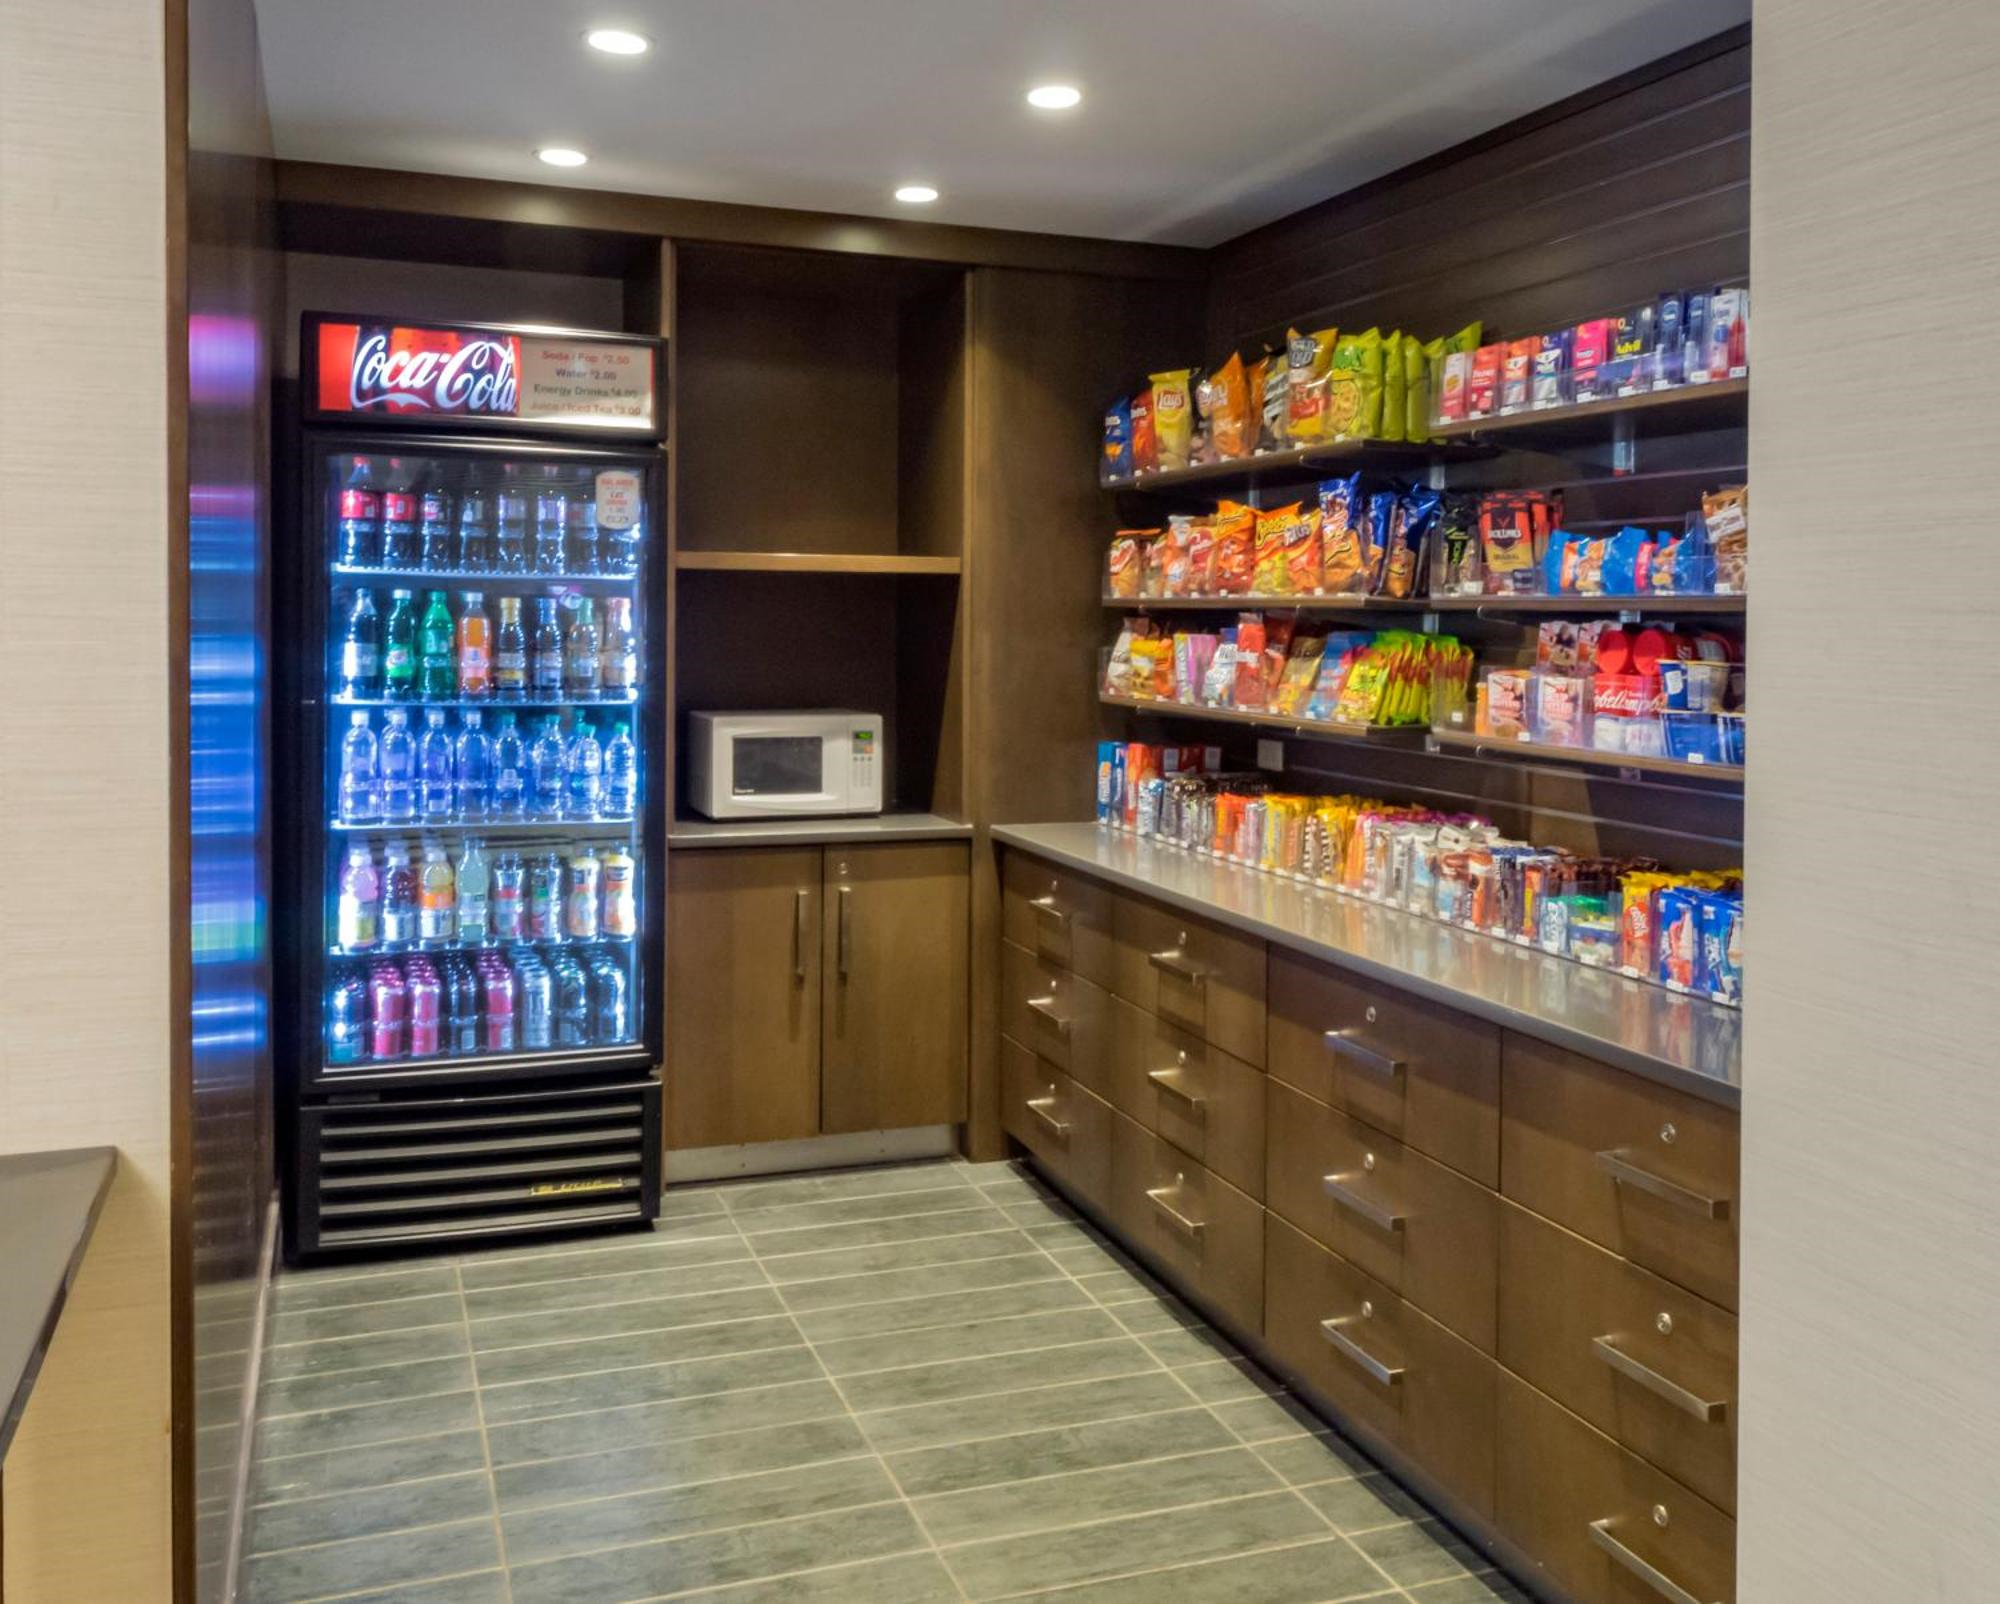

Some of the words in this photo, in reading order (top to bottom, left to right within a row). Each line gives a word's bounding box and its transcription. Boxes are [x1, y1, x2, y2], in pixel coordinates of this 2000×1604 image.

[350, 334, 517, 411] Coca-Cola
[555, 367, 588, 379] Water
[533, 383, 572, 397] Energy
